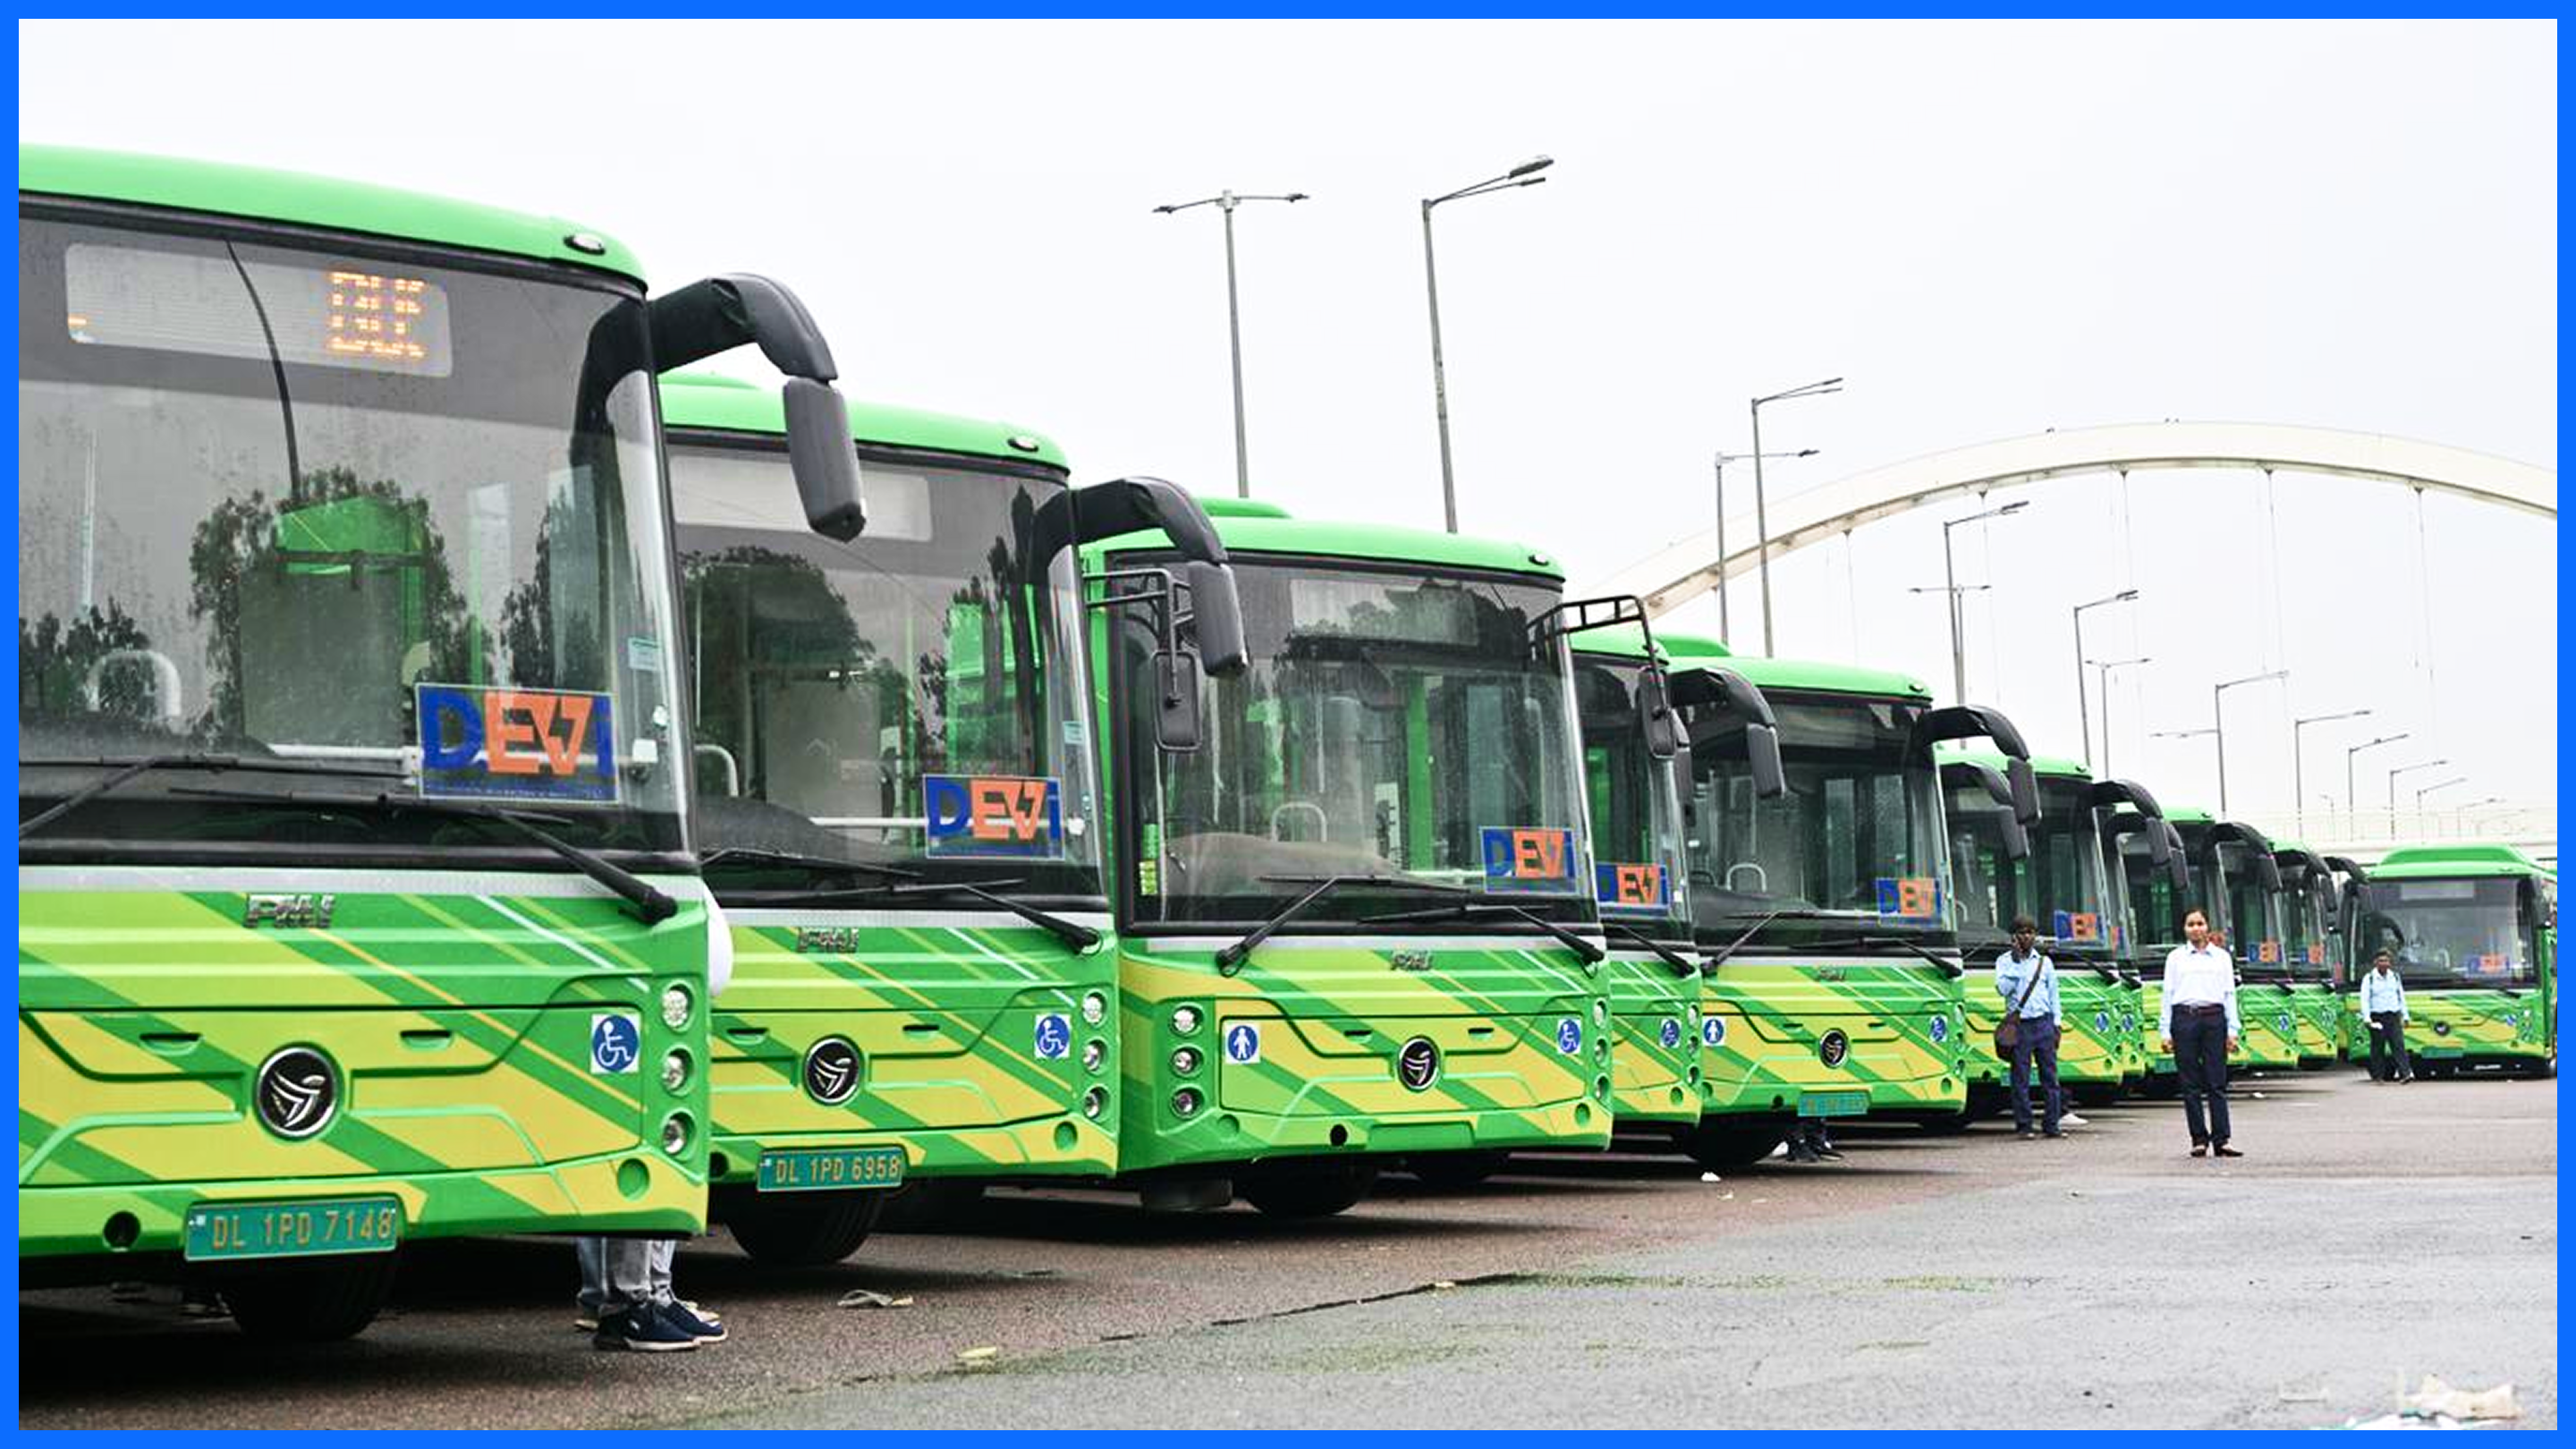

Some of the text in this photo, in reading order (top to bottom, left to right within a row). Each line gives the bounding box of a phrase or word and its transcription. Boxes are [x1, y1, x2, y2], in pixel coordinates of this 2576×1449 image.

[776, 1159, 799, 1183] DL
[852, 1155, 902, 1181] 6958
[213, 1216, 246, 1250] DL
[323, 1208, 392, 1241] 7148
